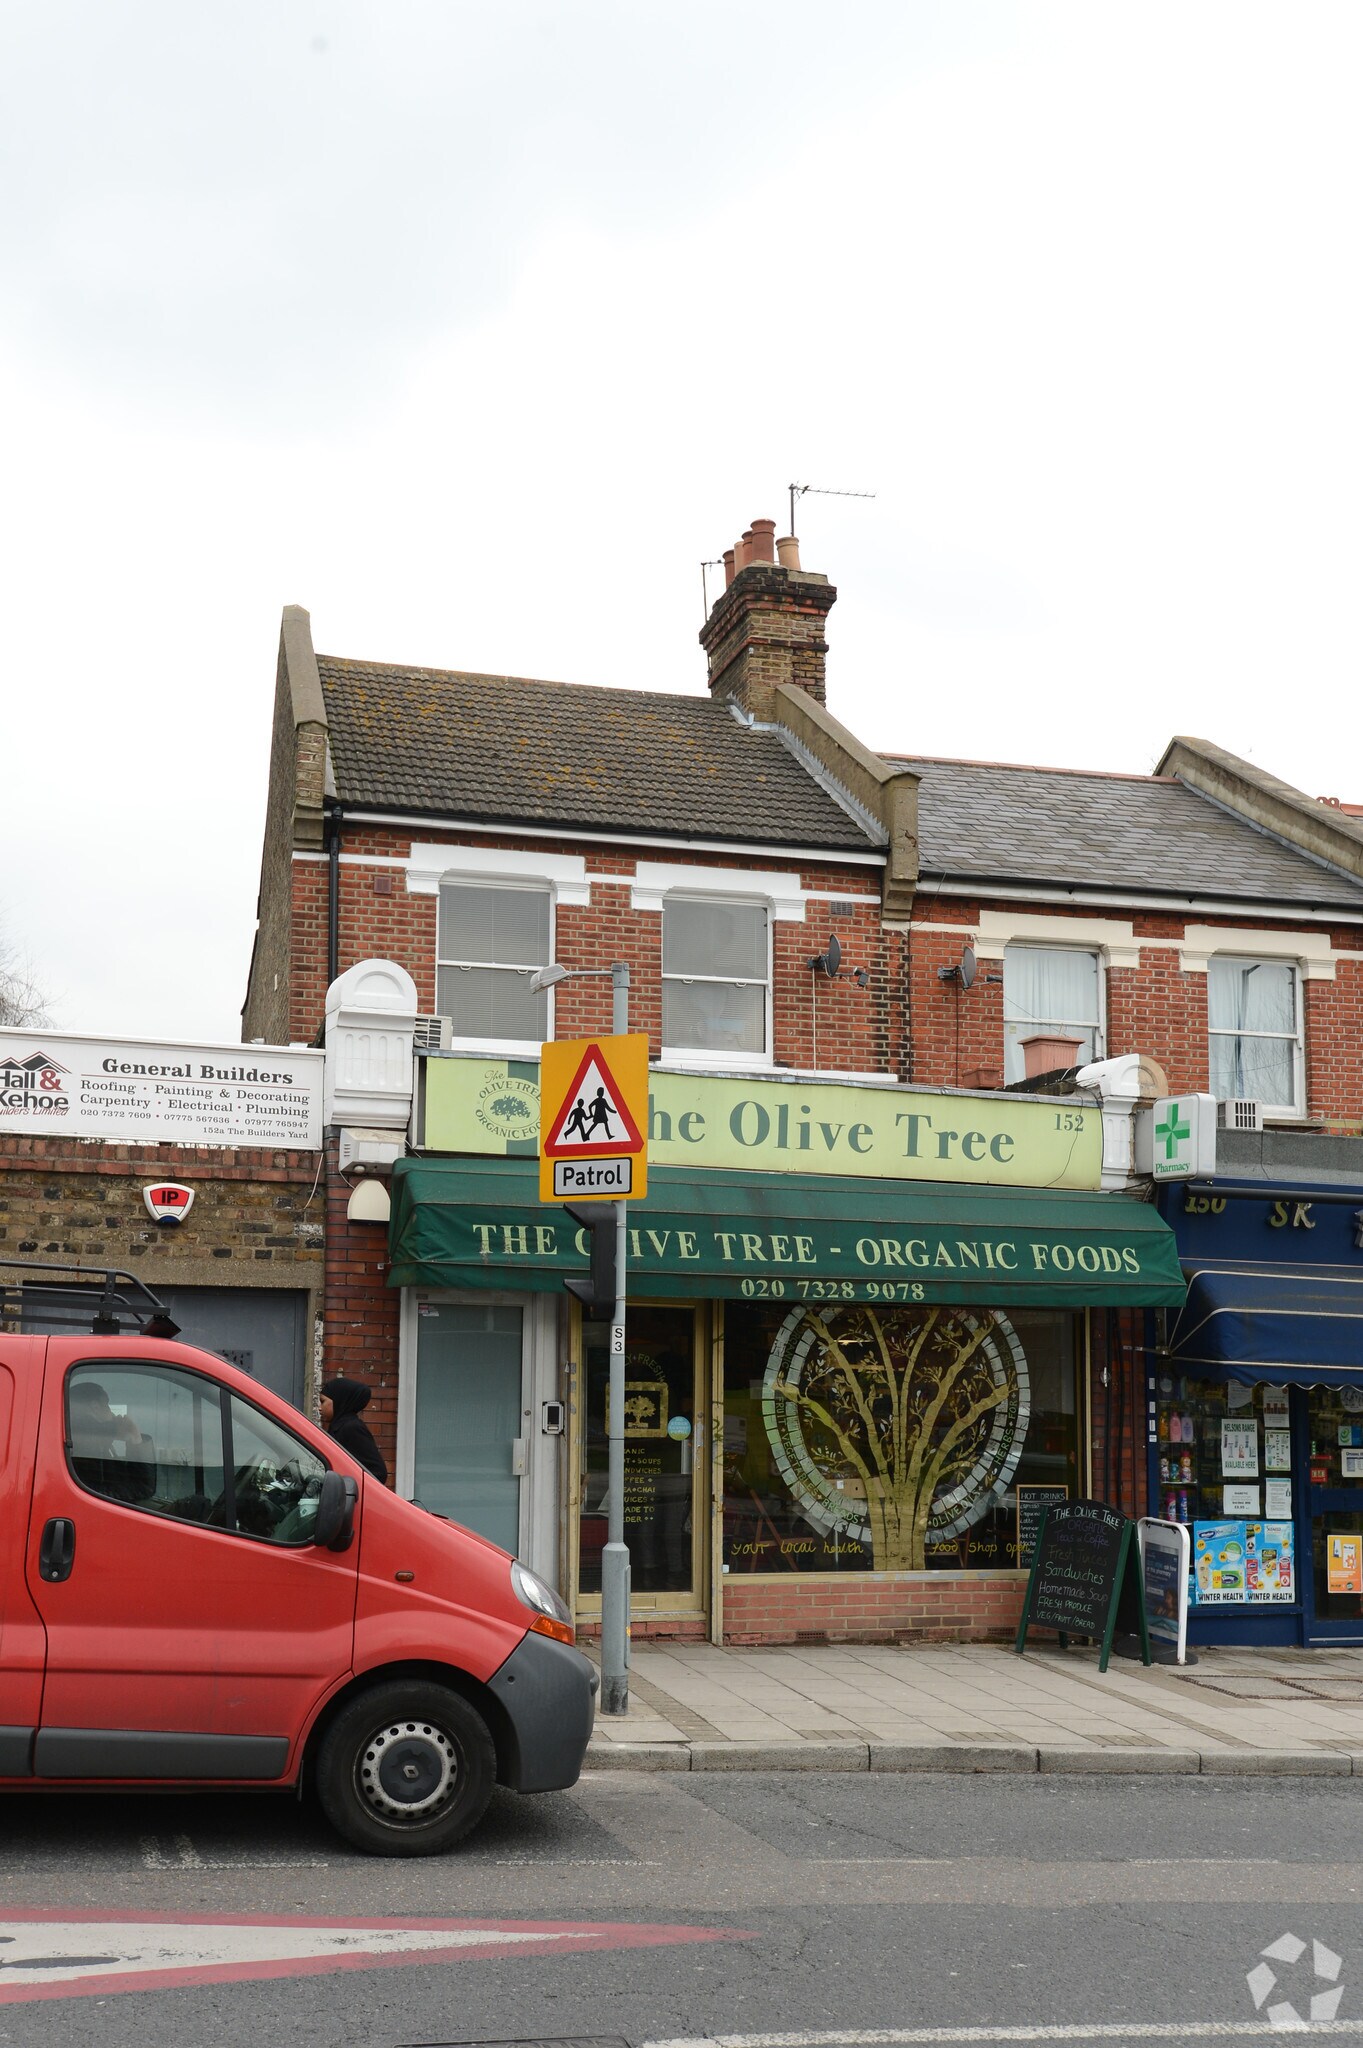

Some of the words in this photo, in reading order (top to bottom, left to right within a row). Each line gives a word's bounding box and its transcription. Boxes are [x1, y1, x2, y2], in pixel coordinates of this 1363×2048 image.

[40, 1069, 63, 1091] &
[102, 1058, 192, 1077] General
[200, 1064, 293, 1084] Builders
[80, 1080, 136, 1095] Roofing
[154, 1084, 213, 1099] Painting
[219, 1089, 230, 1098] &
[236, 1089, 310, 1105] Decorating
[479, 1080, 513, 1099] OLIVE
[0, 1105, 30, 1116] uilders
[33, 1105, 71, 1117] Limited
[80, 1093, 151, 1109] Carpentry
[167, 1099, 233, 1112] Electrical
[245, 1103, 310, 1119] Plumbing
[102, 1110, 125, 1118] 7372
[164, 1113, 193, 1121] 07775
[195, 1116, 230, 1124] 567636
[244, 1118, 273, 1126] 07977
[275, 1120, 309, 1128] 765947
[475, 1109, 520, 1139] ORGANIC
[648, 1093, 706, 1143] he
[729, 1100, 874, 1154] Olive
[895, 1112, 1015, 1164] Tree
[1054, 1112, 1085, 1132] 152
[227, 1127, 245, 1135] The
[247, 1129, 286, 1138] Builders
[288, 1131, 309, 1139] Yard
[562, 1164, 623, 1187] Patrol
[1155, 1162, 1191, 1174] Pharmacy
[161, 1190, 179, 1204] IP
[472, 1224, 558, 1257] THE
[574, 1227, 700, 1261] OIVE
[714, 1233, 817, 1264] TREE
[855, 1237, 1019, 1270] ORGANIC
[1029, 1243, 1140, 1274] FOODS
[741, 1278, 785, 1297] 020
[797, 1280, 856, 1299] 7328
[866, 1282, 925, 1300] 9078
[614, 1327, 623, 1339] S
[614, 1341, 623, 1352] 3
[994, 1428, 1015, 1465] HERBS
[1008, 1398, 1017, 1420] FOR
[775, 1396, 787, 1425] FRUIT
[781, 1432, 818, 1496] VEGETABLES
[1021, 1492, 1037, 1500] HOT
[1040, 1492, 1066, 1500] DRINKS
[932, 1503, 962, 1528] OLIVE
[1053, 1507, 1071, 1520] THE
[1102, 1509, 1120, 1527] TREE
[1045, 1561, 1104, 1585] Sandwiches
[1037, 1596, 1063, 1609] FRESH
[1198, 1593, 1221, 1601] WINTER
[1222, 1592, 1244, 1600] HEALTH
